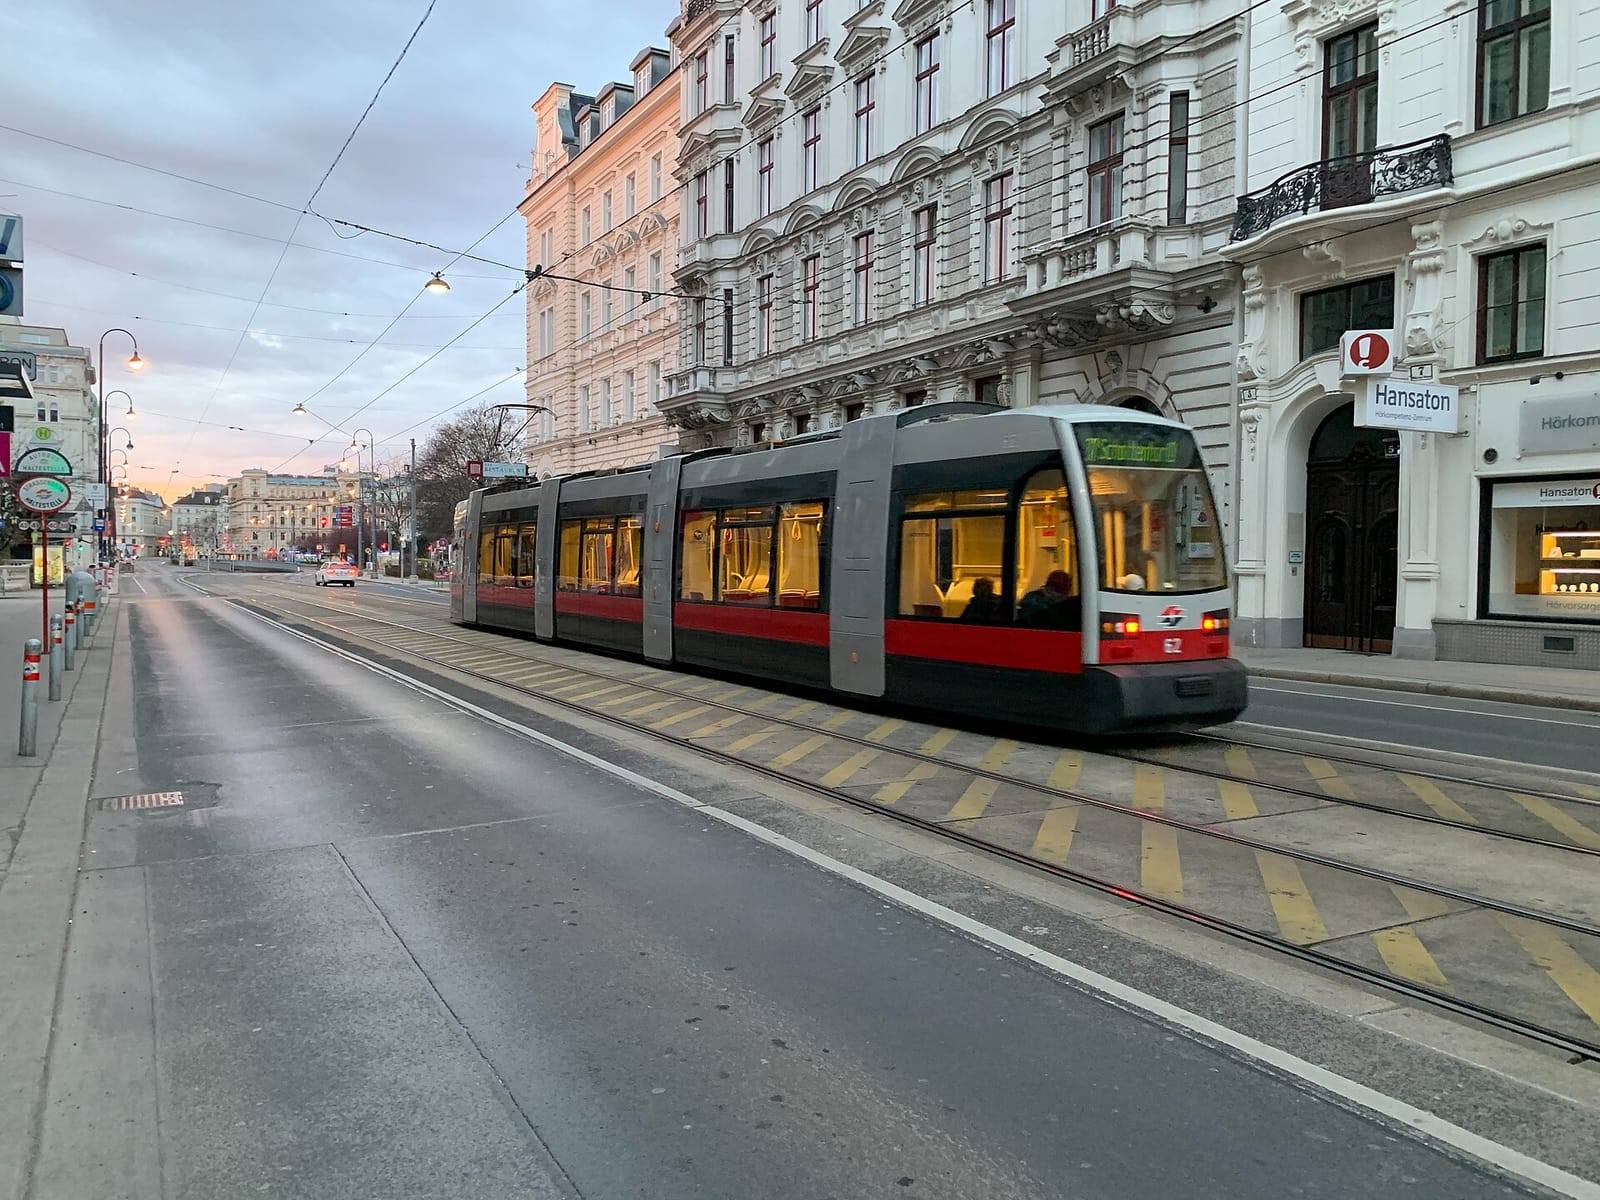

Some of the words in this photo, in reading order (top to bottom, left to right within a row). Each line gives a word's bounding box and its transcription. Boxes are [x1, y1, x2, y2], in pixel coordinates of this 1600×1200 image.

[1418, 366, 1425, 376] 7
[1375, 383, 1450, 411] Hansaton
[1541, 414, 1600, 430] Hörkom
[39, 428, 47, 438] H
[29, 452, 60, 462] AUTOBUS
[1540, 487, 1592, 497] Hansaton
[25, 497, 64, 509] HALTESTELLE
